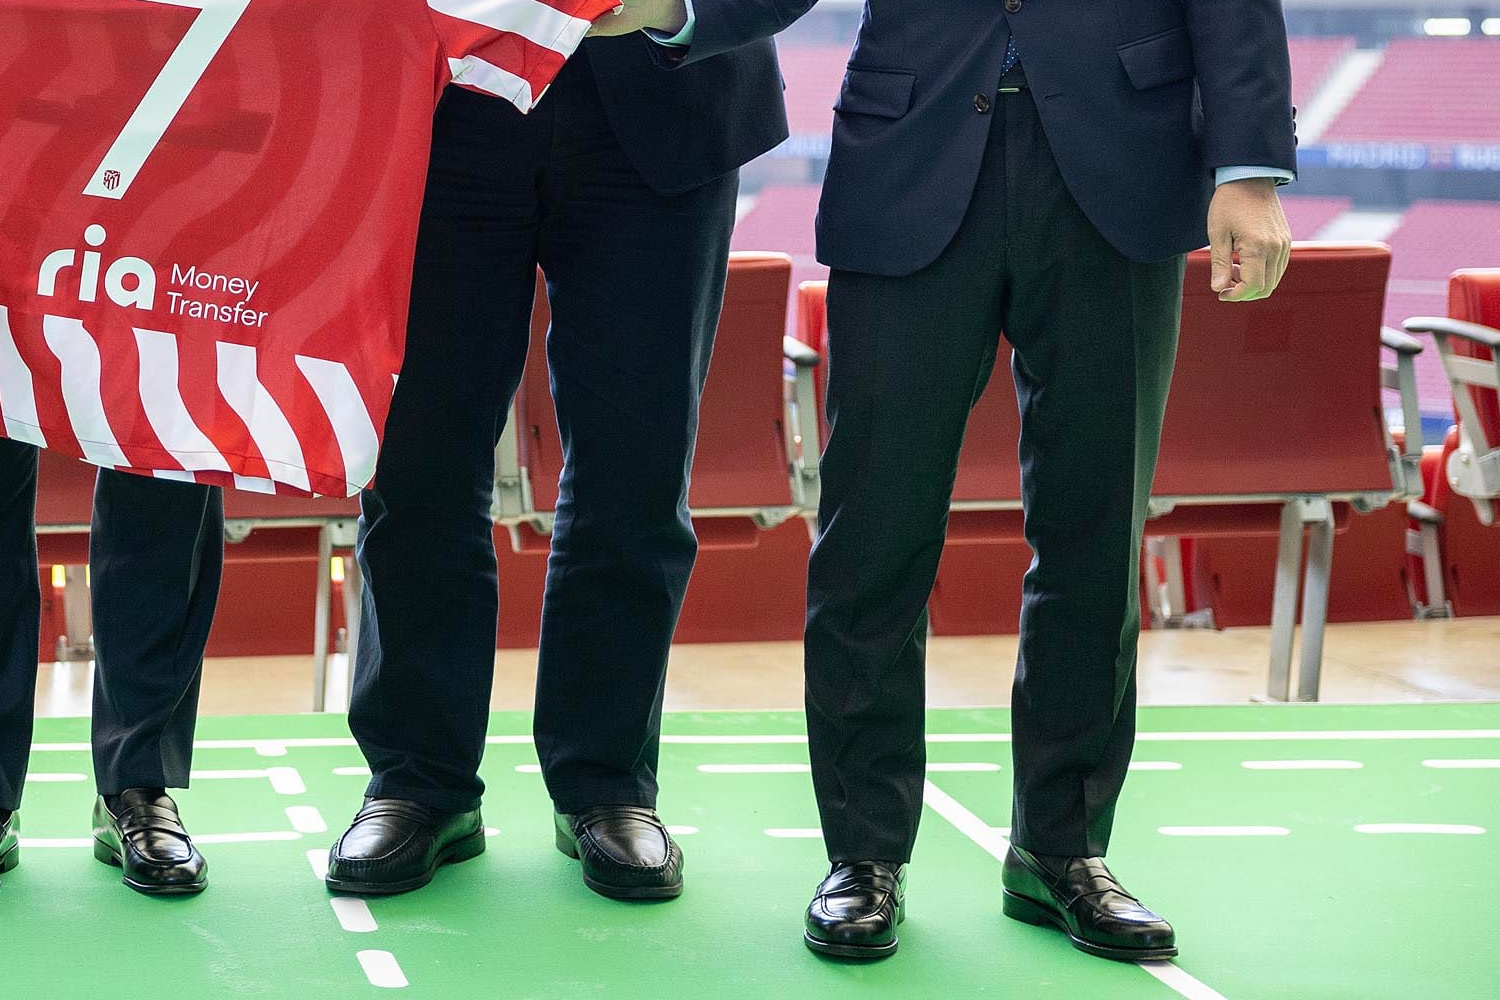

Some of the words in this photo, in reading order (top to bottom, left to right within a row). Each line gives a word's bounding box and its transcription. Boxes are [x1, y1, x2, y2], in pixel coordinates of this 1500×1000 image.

[36, 223, 157, 311] ria
[171, 263, 260, 302] Money
[166, 291, 269, 328] Transfer
